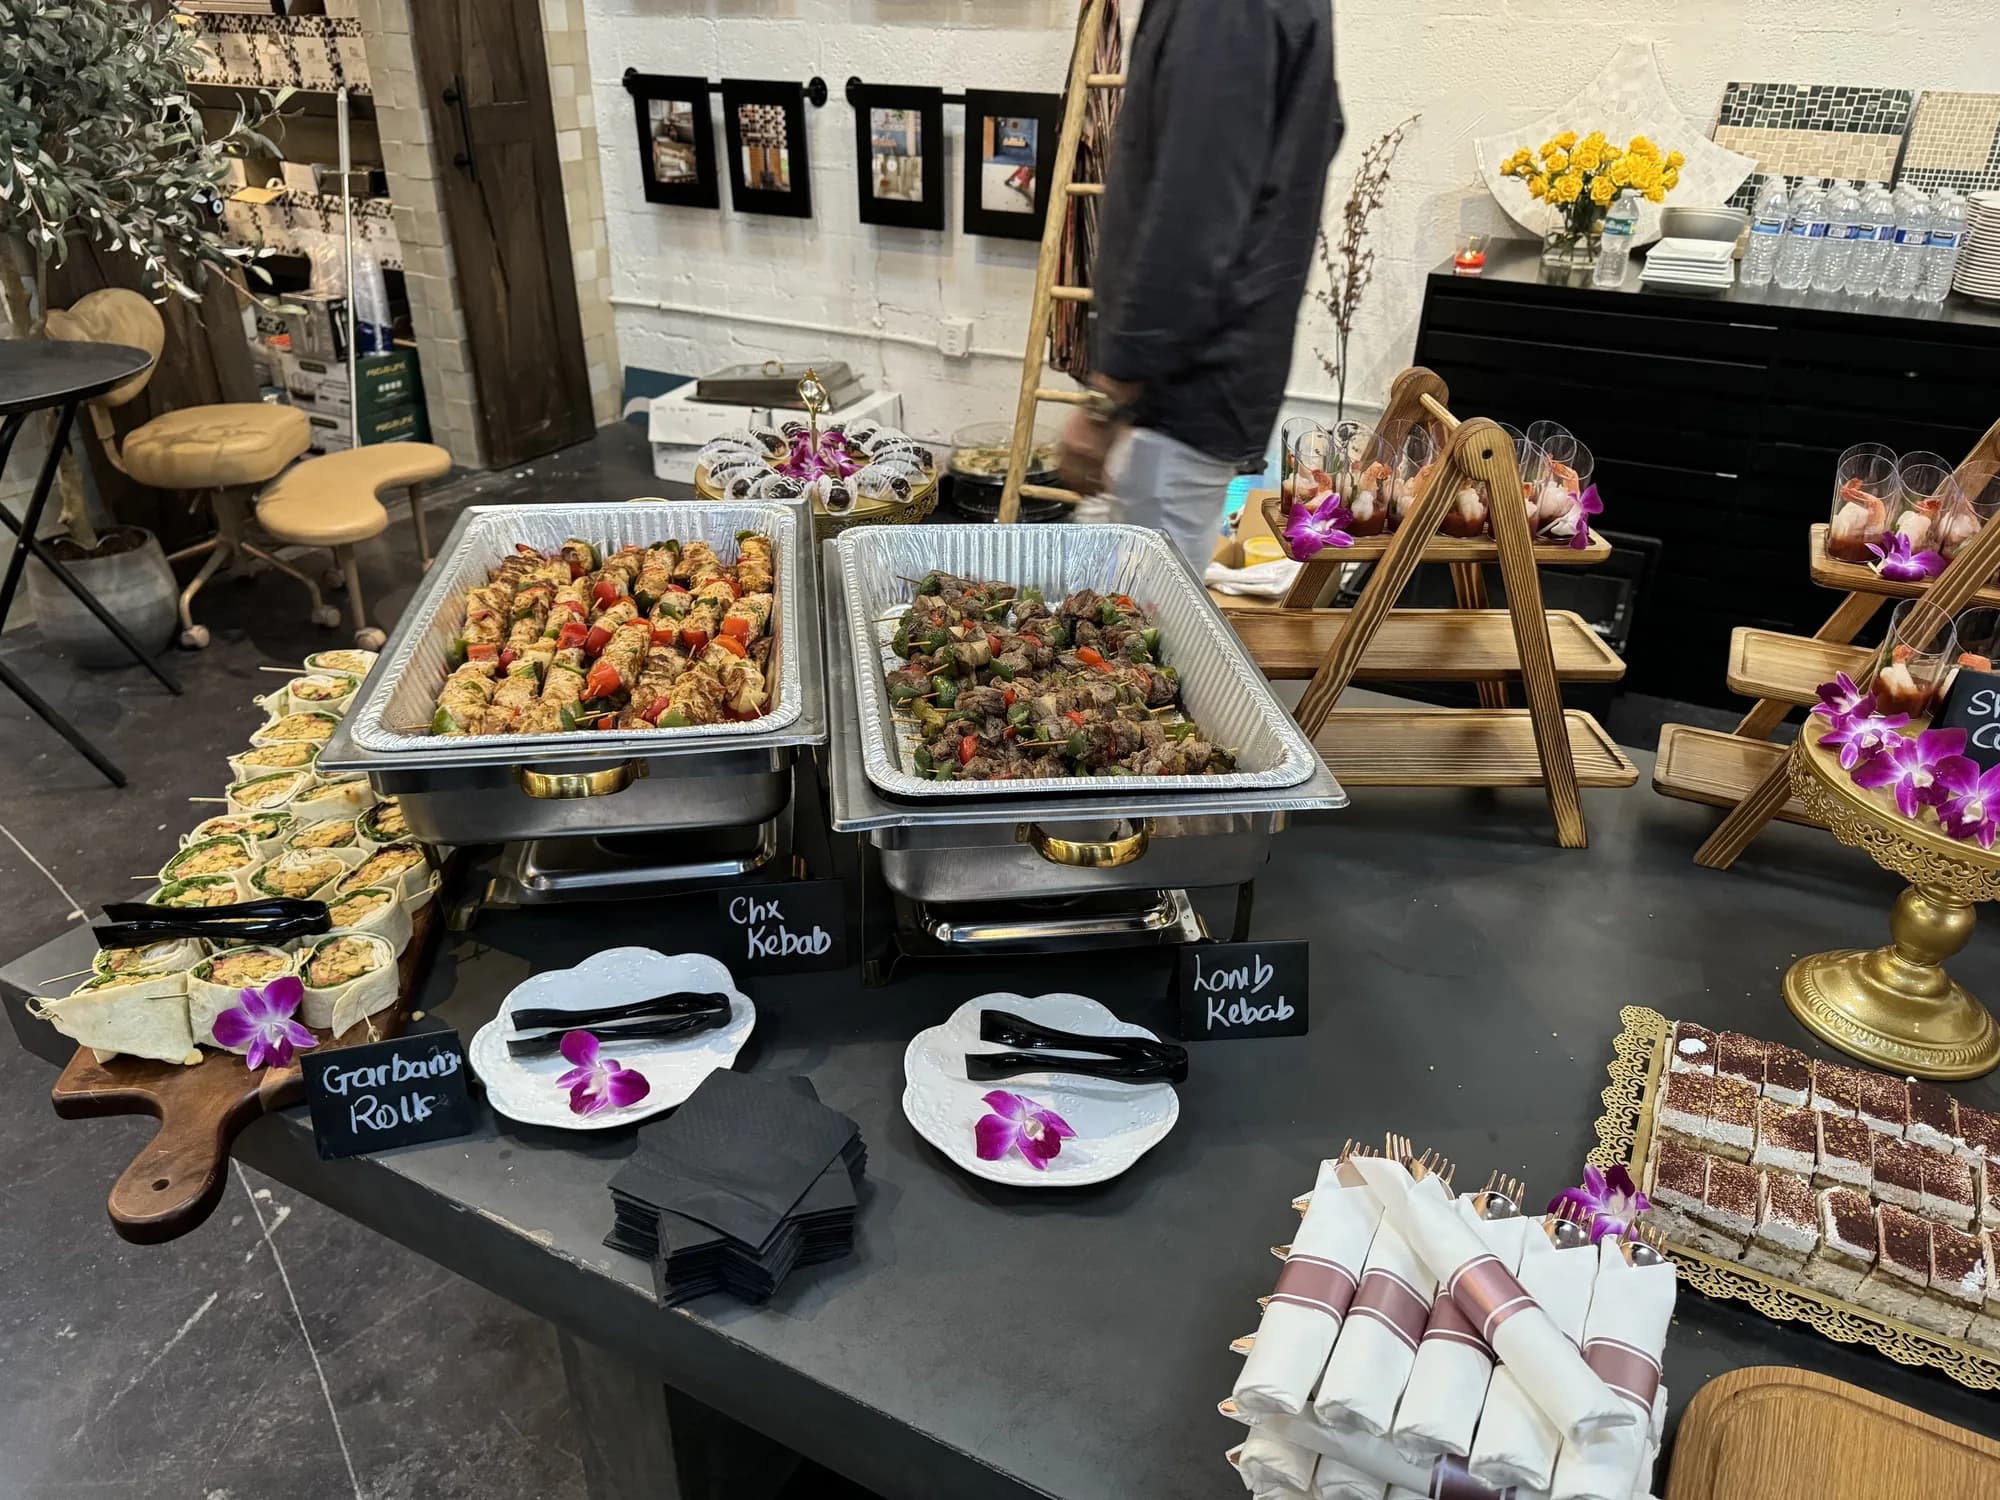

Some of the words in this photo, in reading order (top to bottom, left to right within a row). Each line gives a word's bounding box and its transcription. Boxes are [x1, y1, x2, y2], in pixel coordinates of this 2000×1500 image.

[729, 896, 784, 924] Chx
[748, 925, 831, 959] Kebab
[1207, 995, 1295, 1030] Kebab
